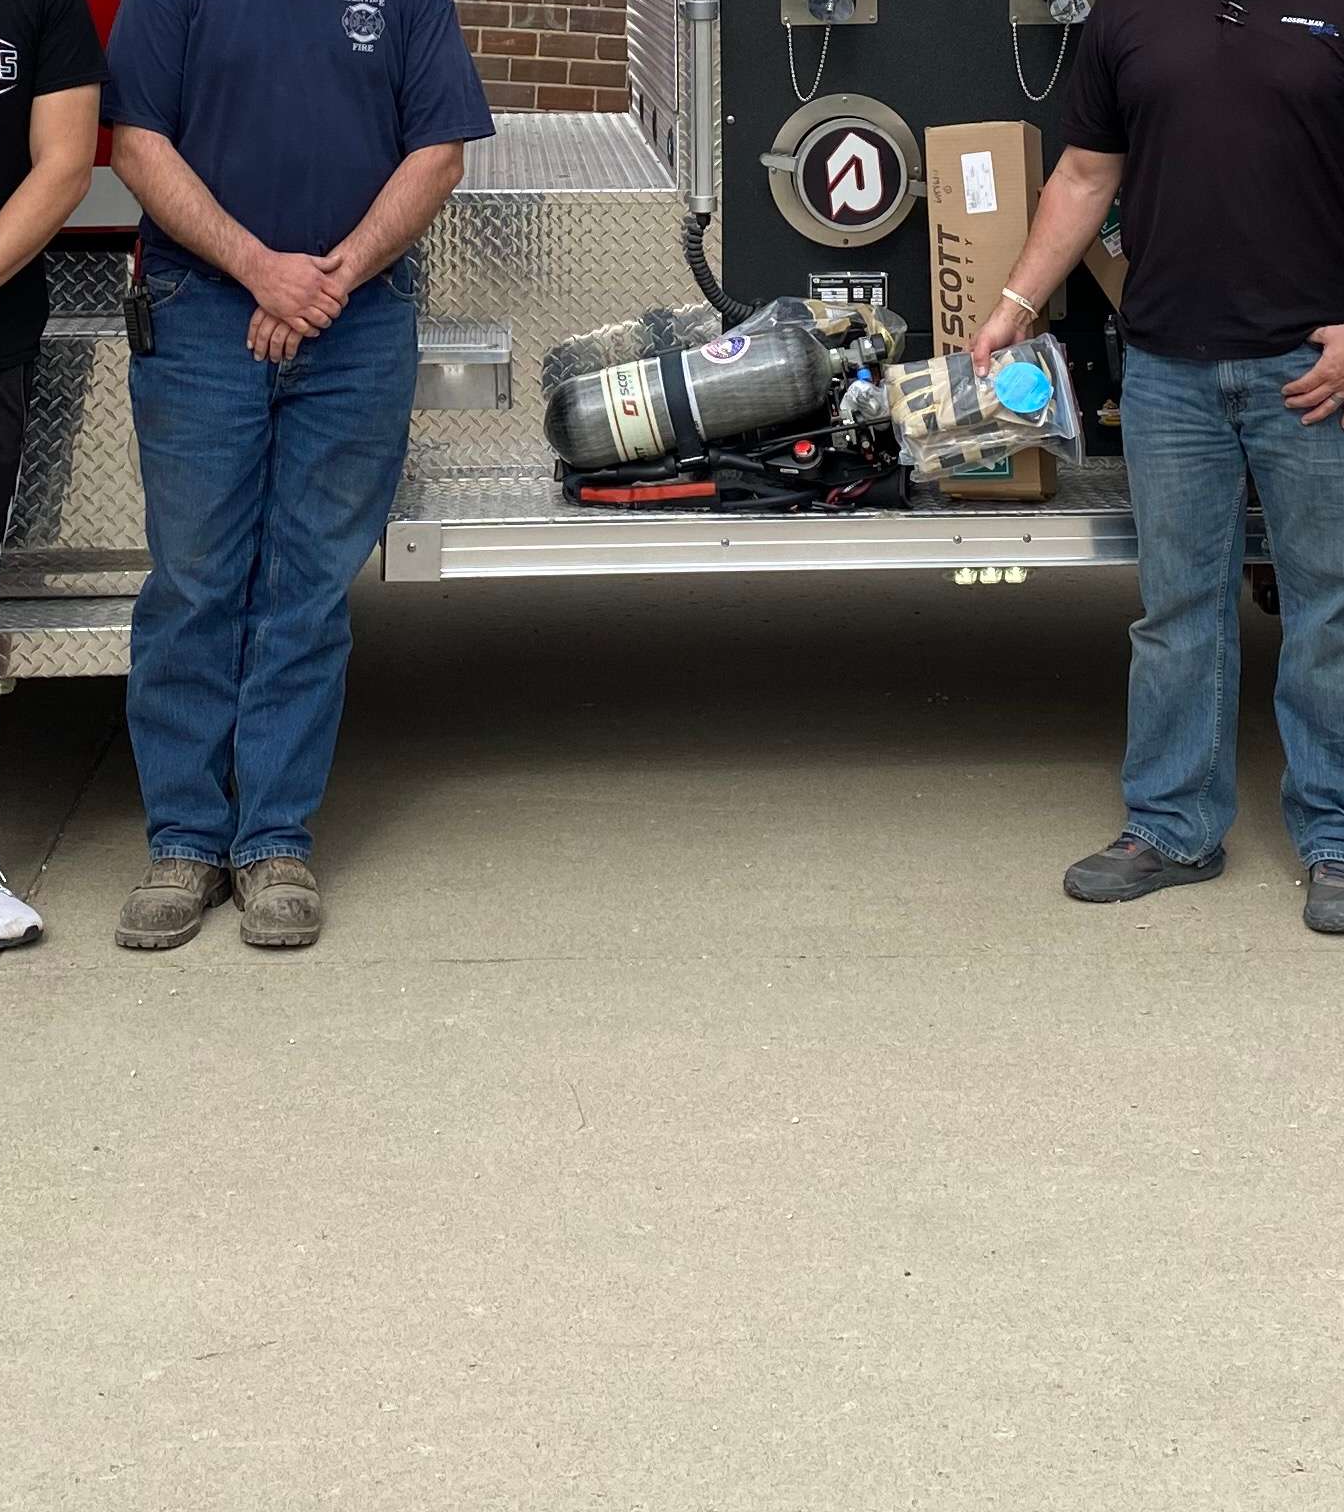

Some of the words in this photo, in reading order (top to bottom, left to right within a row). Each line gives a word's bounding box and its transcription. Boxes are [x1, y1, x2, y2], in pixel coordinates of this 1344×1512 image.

[352, 42, 374, 52] FIRE
[937, 224, 965, 338] SCOTT
[965, 238, 978, 338] AFETY
